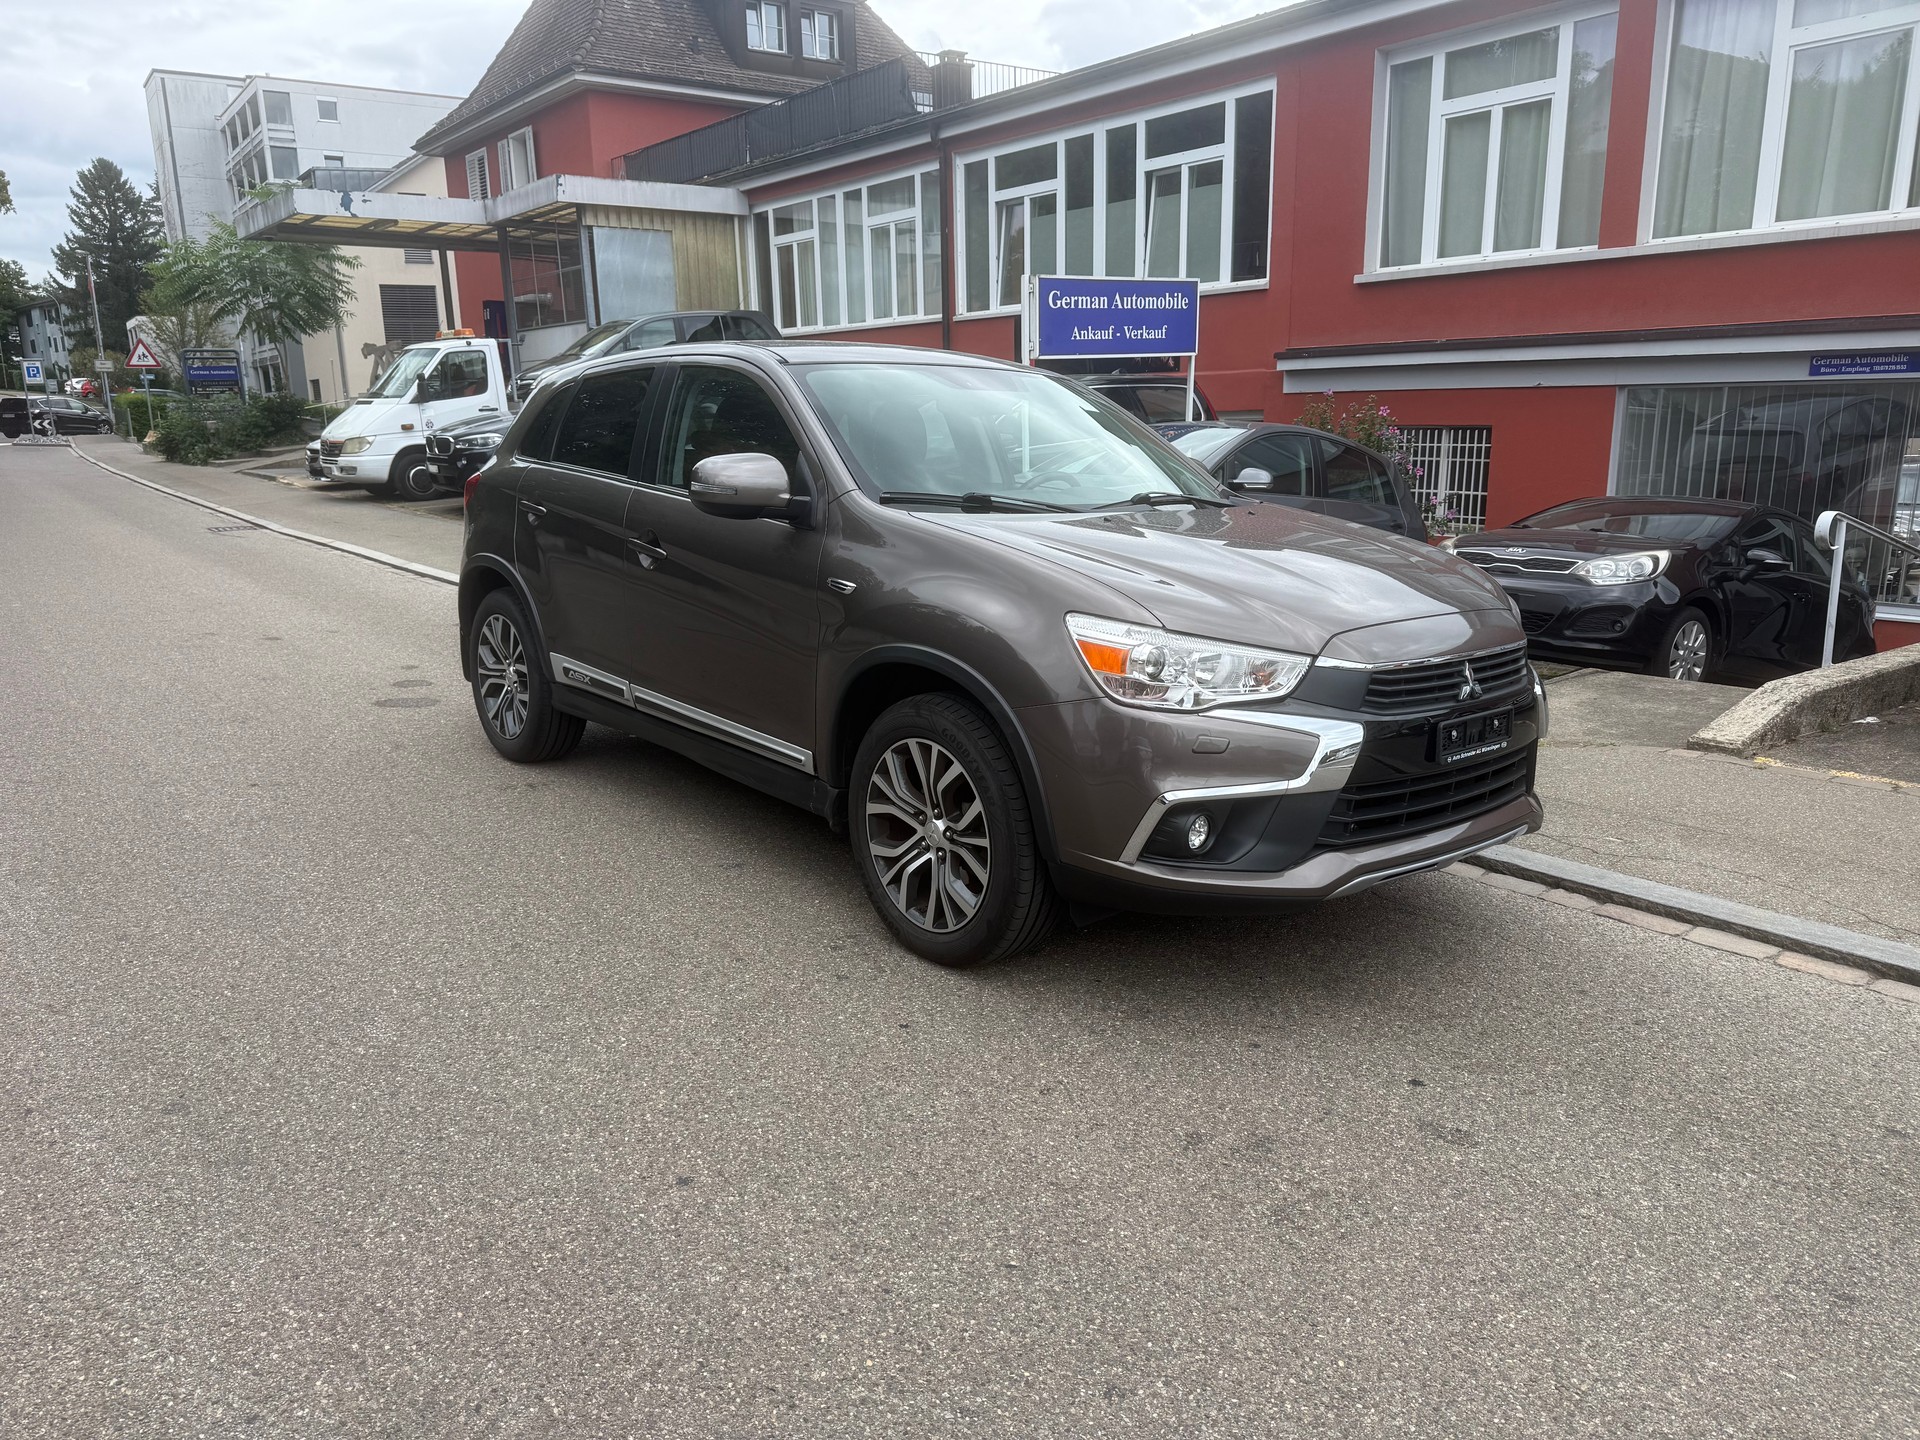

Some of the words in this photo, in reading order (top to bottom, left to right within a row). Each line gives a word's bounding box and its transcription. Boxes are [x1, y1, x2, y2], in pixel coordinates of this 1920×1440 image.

[1048, 290, 1108, 309] German
[1112, 292, 1189, 310] Automobile
[1071, 325, 1114, 340] Ankauf
[1124, 324, 1167, 339] Verkauf
[1813, 357, 1851, 365] German
[1853, 354, 1909, 364] Automobile
[30, 368, 36, 376] P
[1841, 365, 1871, 373] Empfang
[568, 670, 591, 685] ASX
